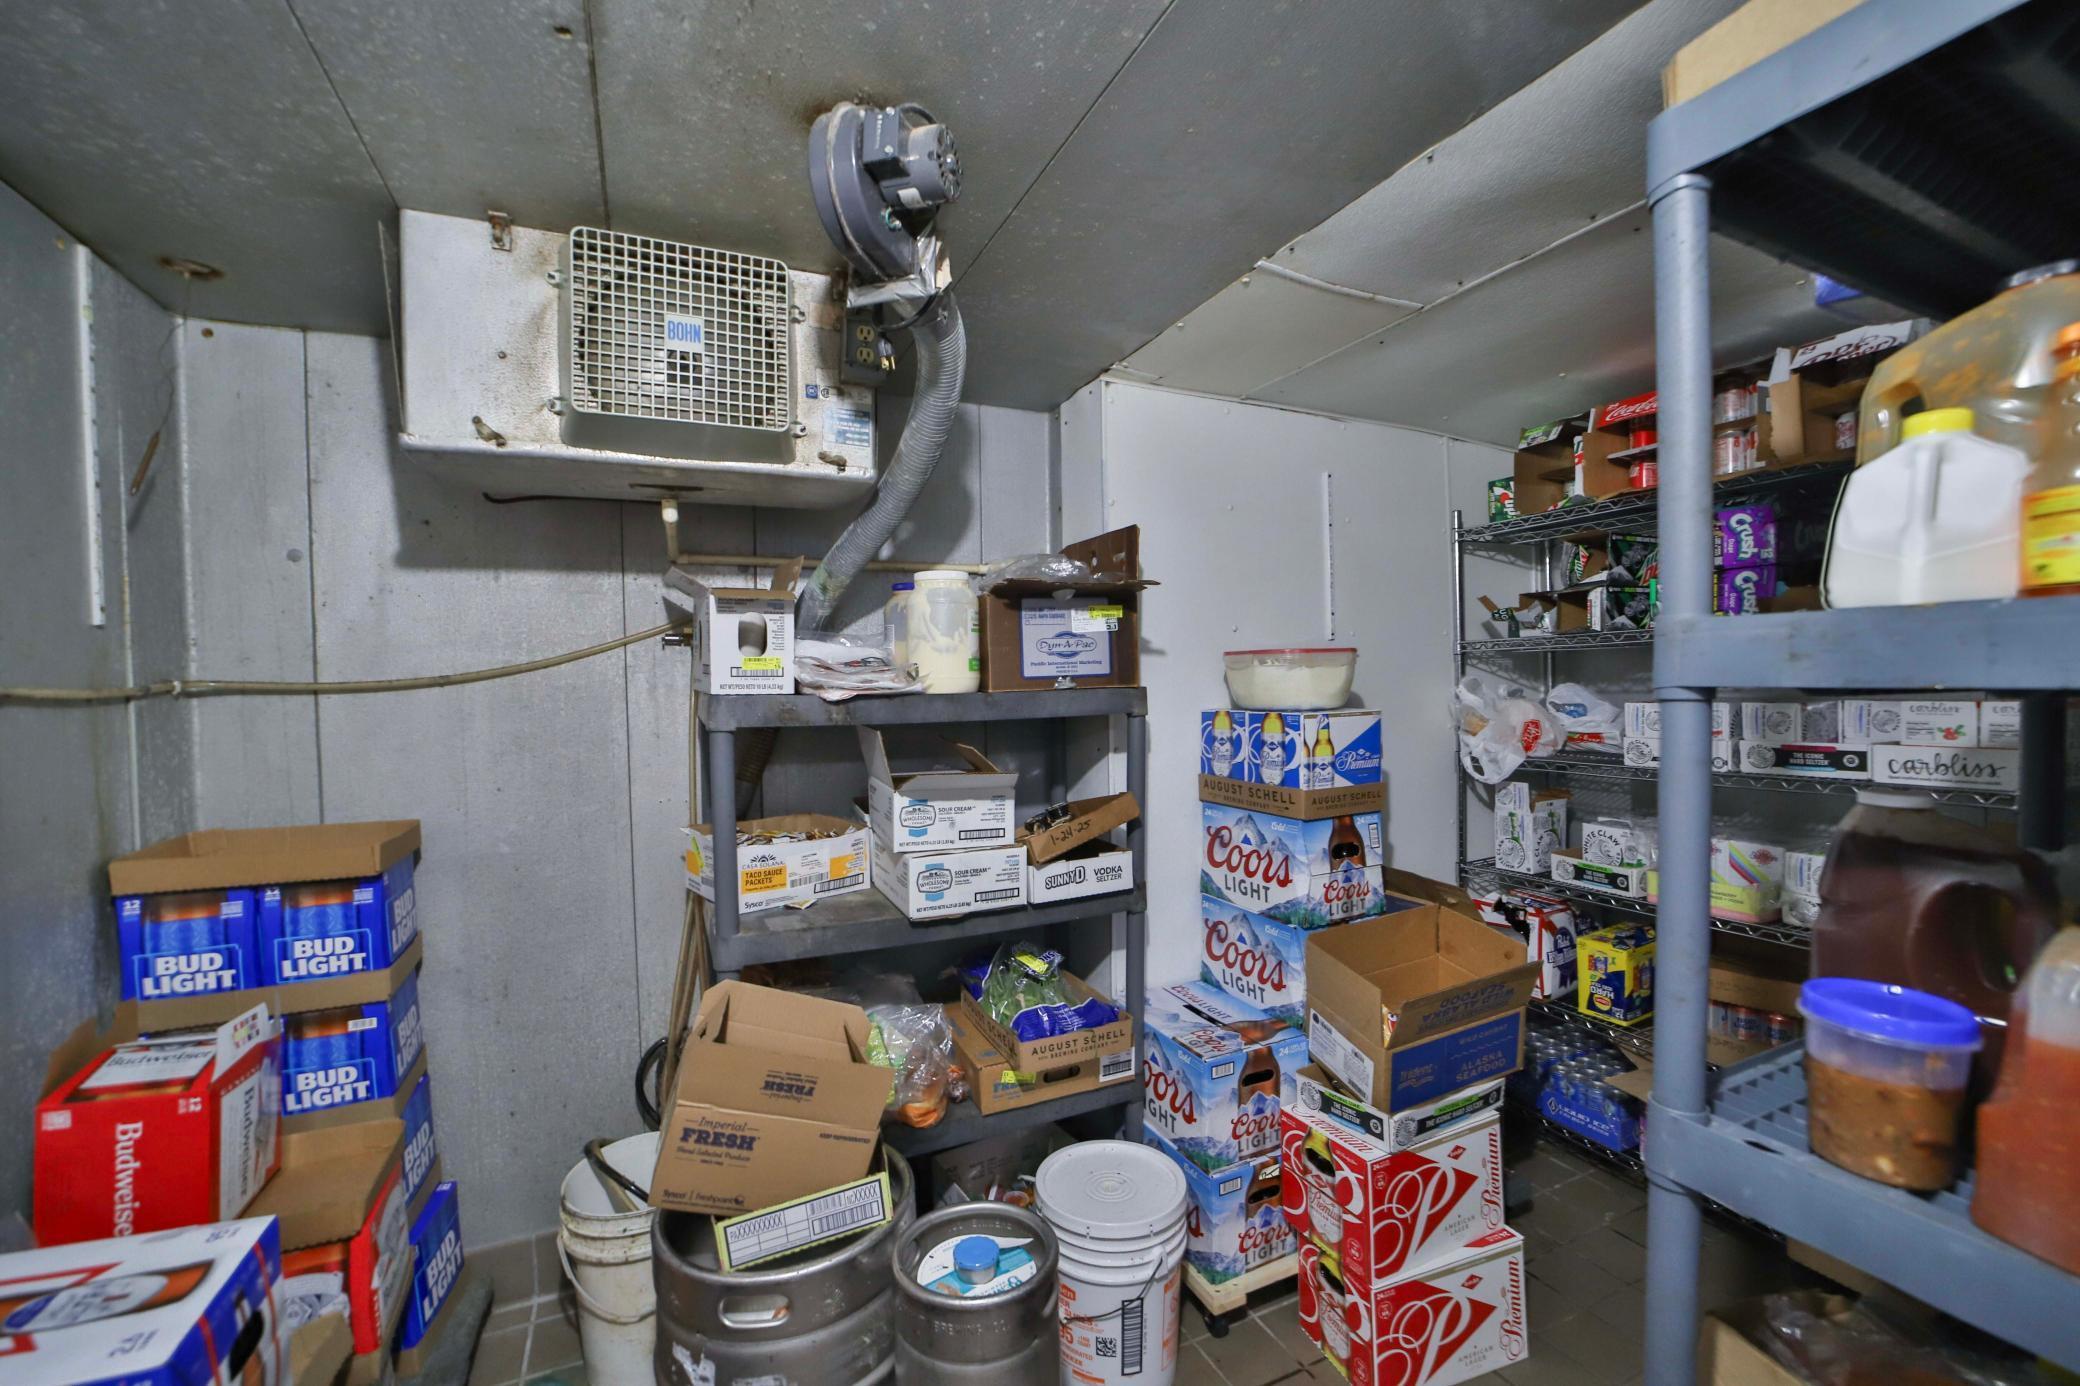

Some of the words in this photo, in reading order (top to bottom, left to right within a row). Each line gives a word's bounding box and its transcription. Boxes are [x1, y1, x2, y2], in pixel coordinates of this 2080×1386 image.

[667, 320, 702, 344] BOHN
[1729, 513, 1758, 559] Crush
[1335, 751, 1380, 771] Premium
[1888, 753, 2007, 780] carbliss
[1203, 779, 1243, 797] AUGUST
[1248, 787, 1296, 805] SCHELL
[1311, 794, 1347, 805] AUGUST
[1349, 790, 1382, 801] SCHELL
[1050, 820, 1091, 846] 1-24-25
[1597, 829, 1620, 847] CLAW
[1206, 825, 1294, 888] Coors
[745, 871, 762, 879] TACO
[763, 868, 783, 877] SAUCE
[745, 877, 773, 887] PACKETS
[1094, 865, 1123, 876] VODKA
[1096, 873, 1122, 883] SELTZER
[1224, 874, 1271, 903] LIGHT
[1322, 879, 1371, 904] Coors
[393, 888, 414, 924] BUD
[744, 901, 763, 909] Sysco
[1329, 898, 1366, 917] LIGHT
[392, 908, 418, 953] LIGHT
[293, 937, 355, 959] BUD
[1205, 918, 1287, 992] Coors
[155, 953, 223, 976] BUD
[281, 953, 367, 978] LIGHT
[142, 969, 236, 996] LIGHT
[1222, 968, 1266, 1003] LIGHT
[1590, 986, 1614, 999] HARD
[1200, 999, 1233, 1020] LIGHT
[398, 1005, 418, 1043] BUD
[397, 1023, 423, 1076] LIGHT
[1031, 1039, 1078, 1056] AUGUST
[1083, 1028, 1126, 1046] SCHELL
[1050, 1049, 1078, 1059] BREWING
[1080, 1042, 1110, 1054] COMPANY
[1278, 1047, 1289, 1057] 24
[1456, 1059, 1507, 1082] SEAFOOD
[1461, 1051, 1504, 1070] ALASKA
[296, 1066, 358, 1091] BUD
[762, 1080, 816, 1096] FRESH
[285, 1081, 370, 1112] LIGHT
[1143, 1060, 1197, 1124] oors
[698, 1116, 748, 1132] Imperial
[404, 1120, 430, 1172] BUD
[680, 1127, 756, 1151] FRESH
[724, 1151, 750, 1161] Produce
[113, 1121, 144, 1237] Budweise
[1481, 1128, 1502, 1230] Premium
[1444, 1215, 1476, 1232] AMERICAN
[1450, 1224, 1470, 1235] LAGER
[427, 1229, 456, 1283] BUD
[1244, 1238, 1288, 1266] LIGHT
[423, 1241, 463, 1322] LIGHT
[1500, 1256, 1523, 1361] Premium
[1458, 1345, 1494, 1363] AMERICAN
[1464, 1354, 1487, 1367] LAGER
